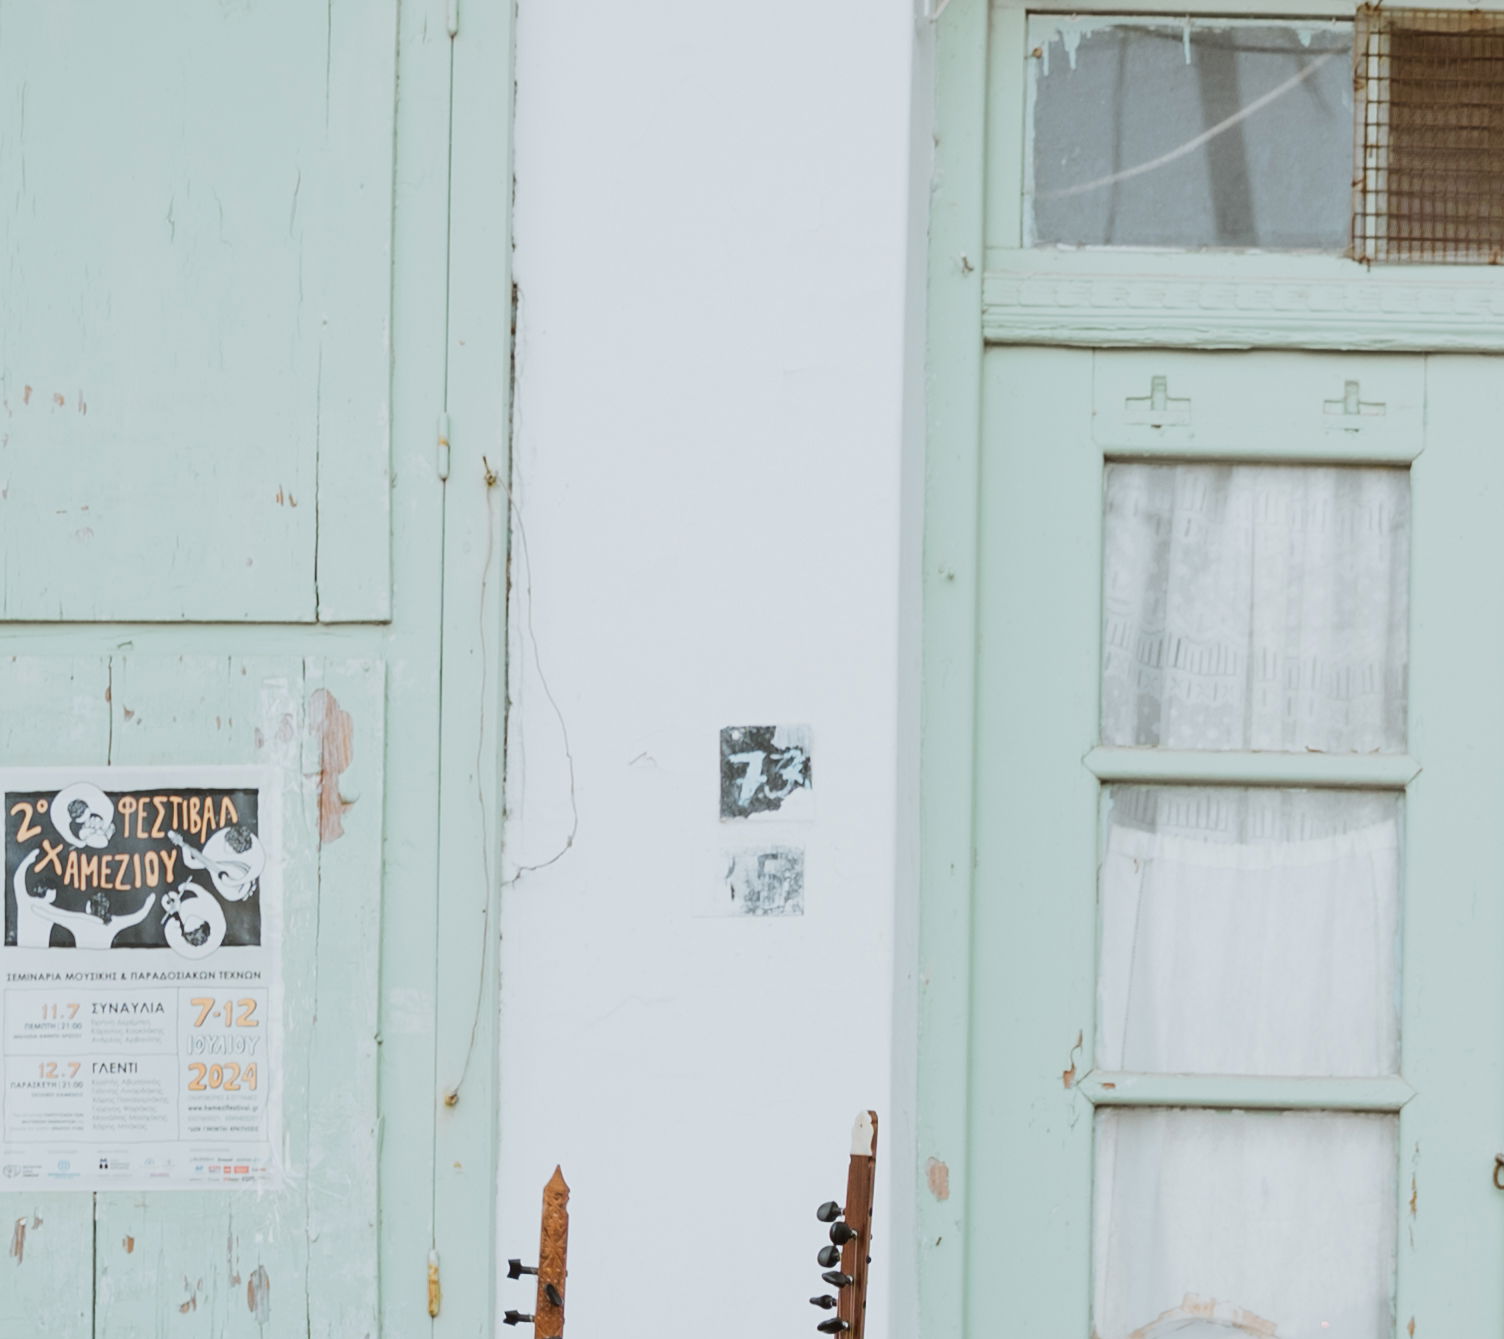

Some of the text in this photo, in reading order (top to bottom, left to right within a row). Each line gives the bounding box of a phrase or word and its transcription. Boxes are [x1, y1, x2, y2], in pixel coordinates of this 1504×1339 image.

[118, 796, 239, 843] ΦΕΣΤΙΒΑΛ
[34, 839, 178, 891] ΧΑΜΕΖΙΟΥ
[91, 1002, 165, 1014] ΣΥΝΑΥΛΙΑ
[92, 1062, 138, 1074] ΓΛΕΝΤΙ
[187, 1062, 258, 1091] 2024
